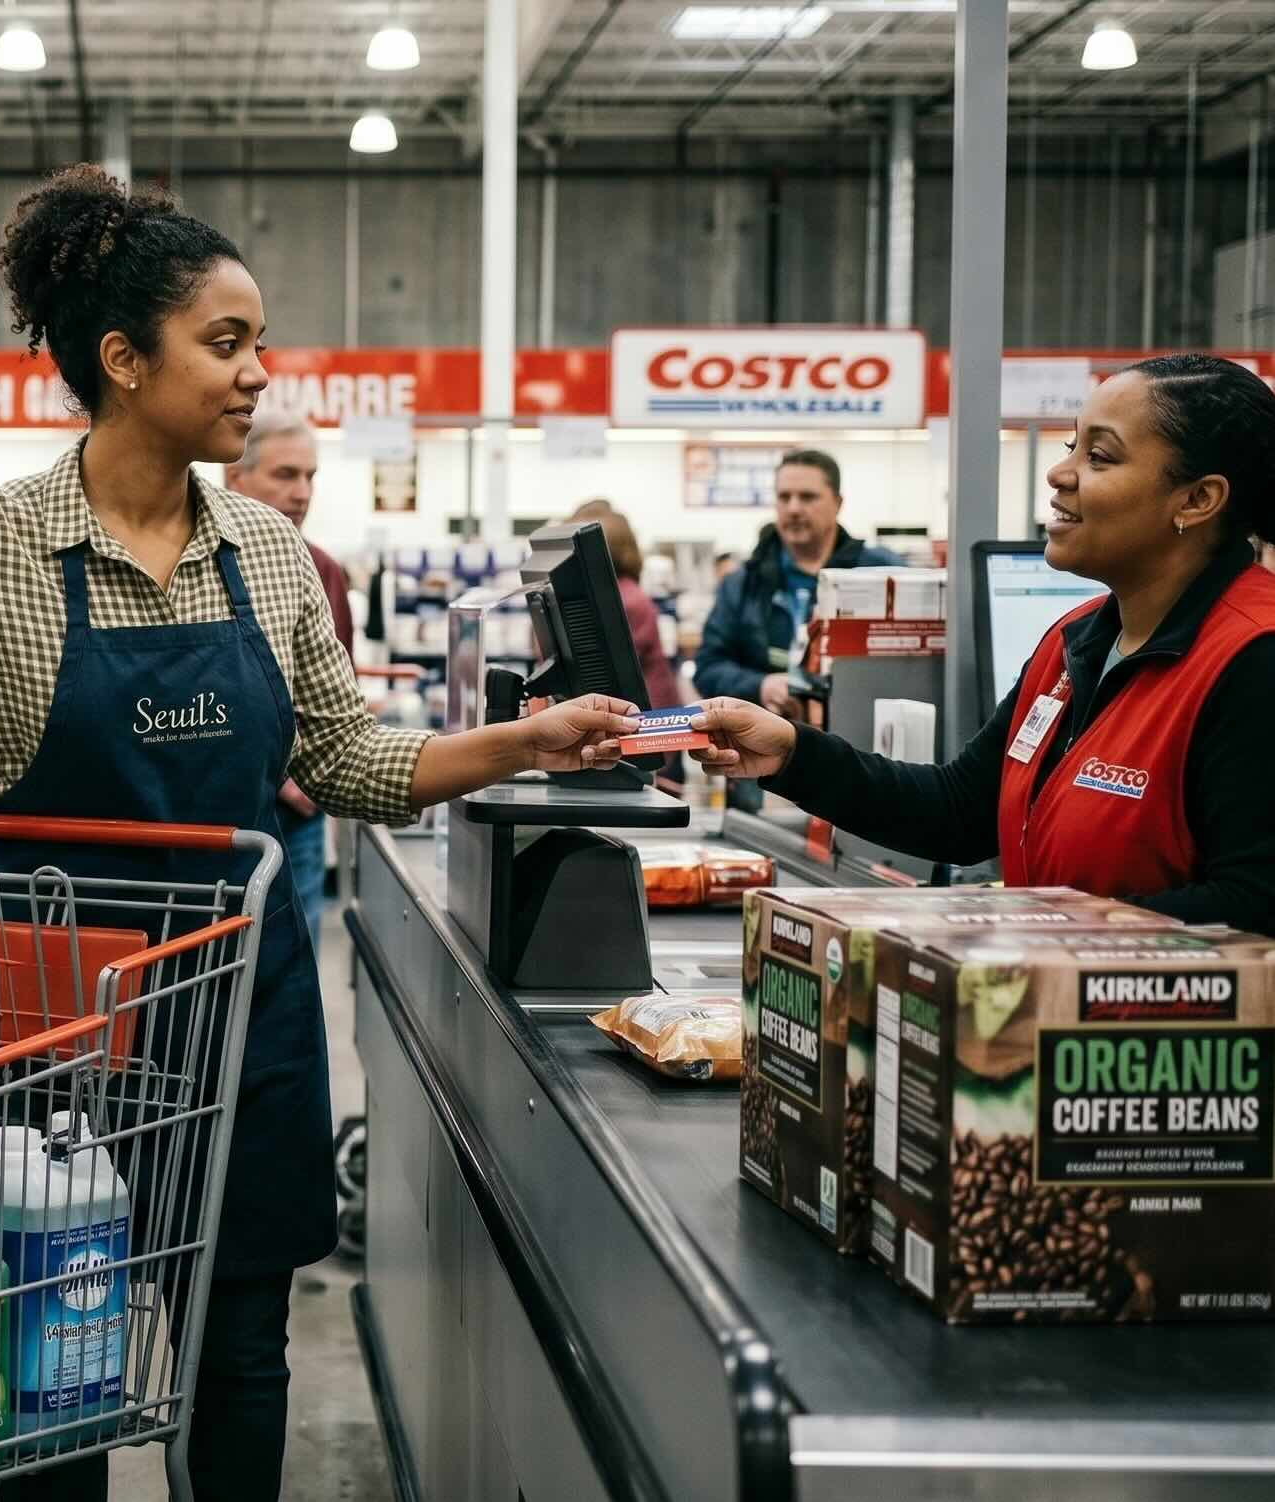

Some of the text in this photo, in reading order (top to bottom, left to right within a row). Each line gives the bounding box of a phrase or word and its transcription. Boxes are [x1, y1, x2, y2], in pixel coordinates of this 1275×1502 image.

[647, 349, 890, 390] COSTCO
[1081, 758, 1149, 788] COSTCO
[762, 961, 818, 1028] ORGANIC
[1086, 975, 1233, 1003] KIRKLAND
[1053, 1038, 1260, 1094] ORGANIC
[1052, 1096, 1260, 1133] COFFEE BEANS
